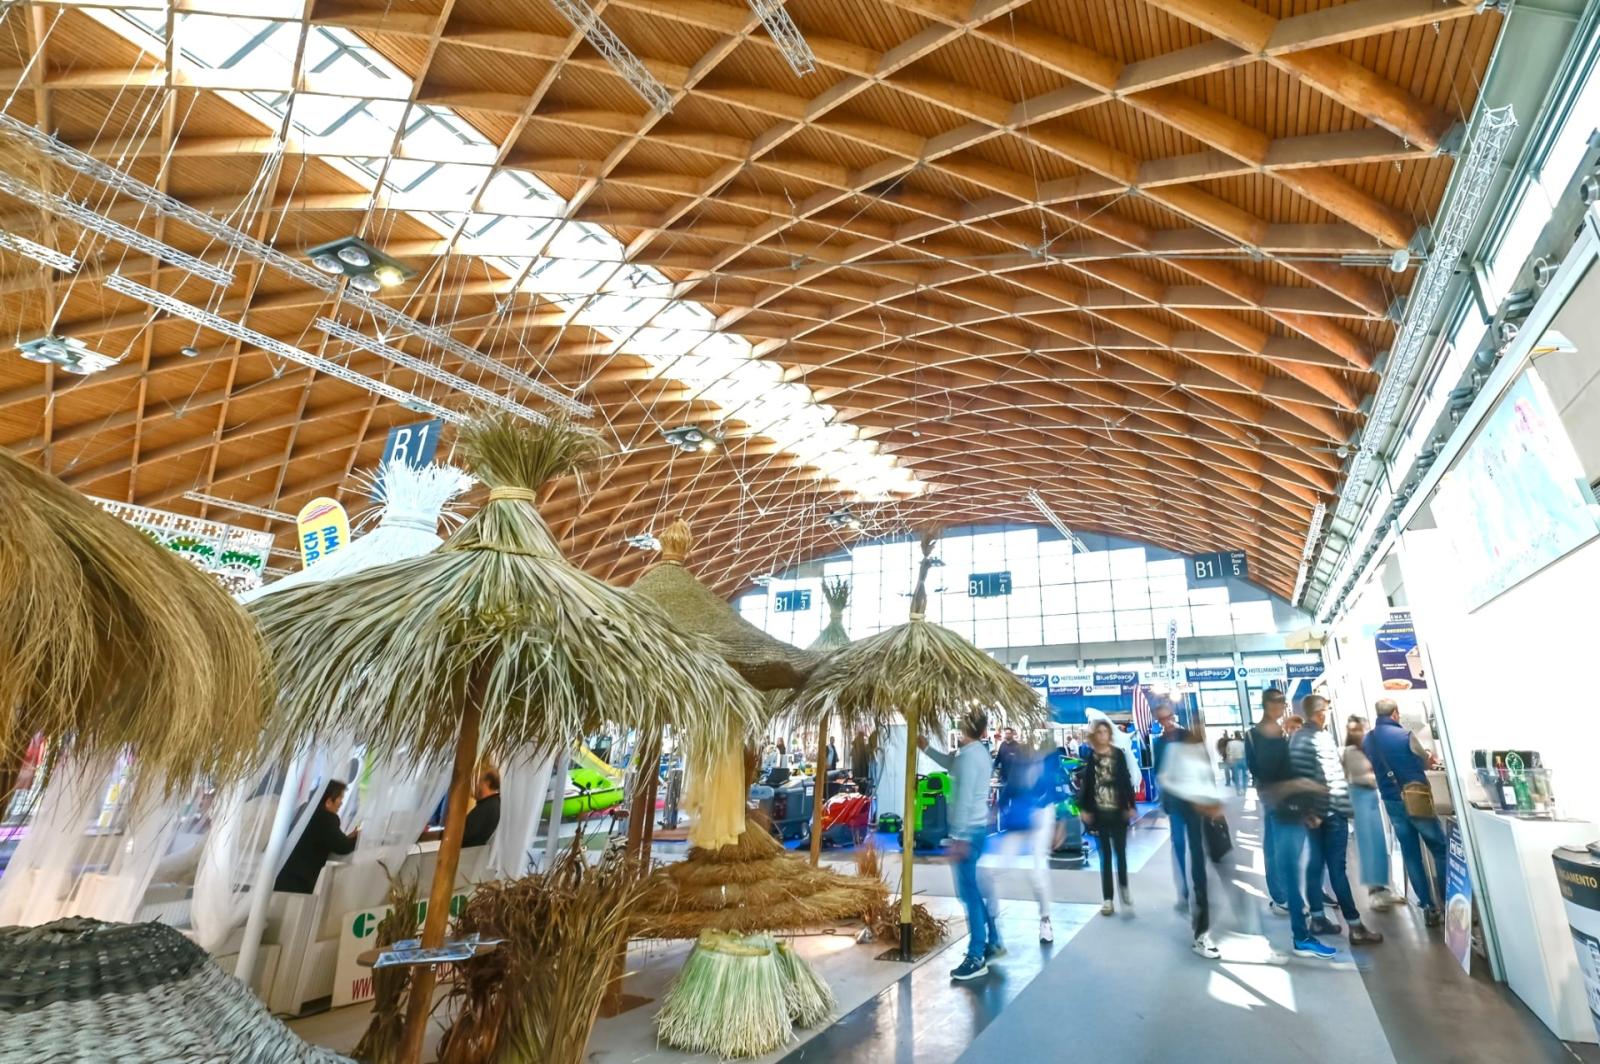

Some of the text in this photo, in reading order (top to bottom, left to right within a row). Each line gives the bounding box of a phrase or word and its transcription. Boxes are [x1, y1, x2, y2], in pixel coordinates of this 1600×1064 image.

[389, 424, 430, 463] B1
[1195, 560, 1214, 578] B1
[1233, 564, 1240, 576] 5
[970, 580, 984, 596] B1
[999, 583, 1006, 594] 4
[774, 597, 788, 611] B1
[800, 599, 806, 610] 3
[1248, 666, 1284, 674] HOTELMARKET
